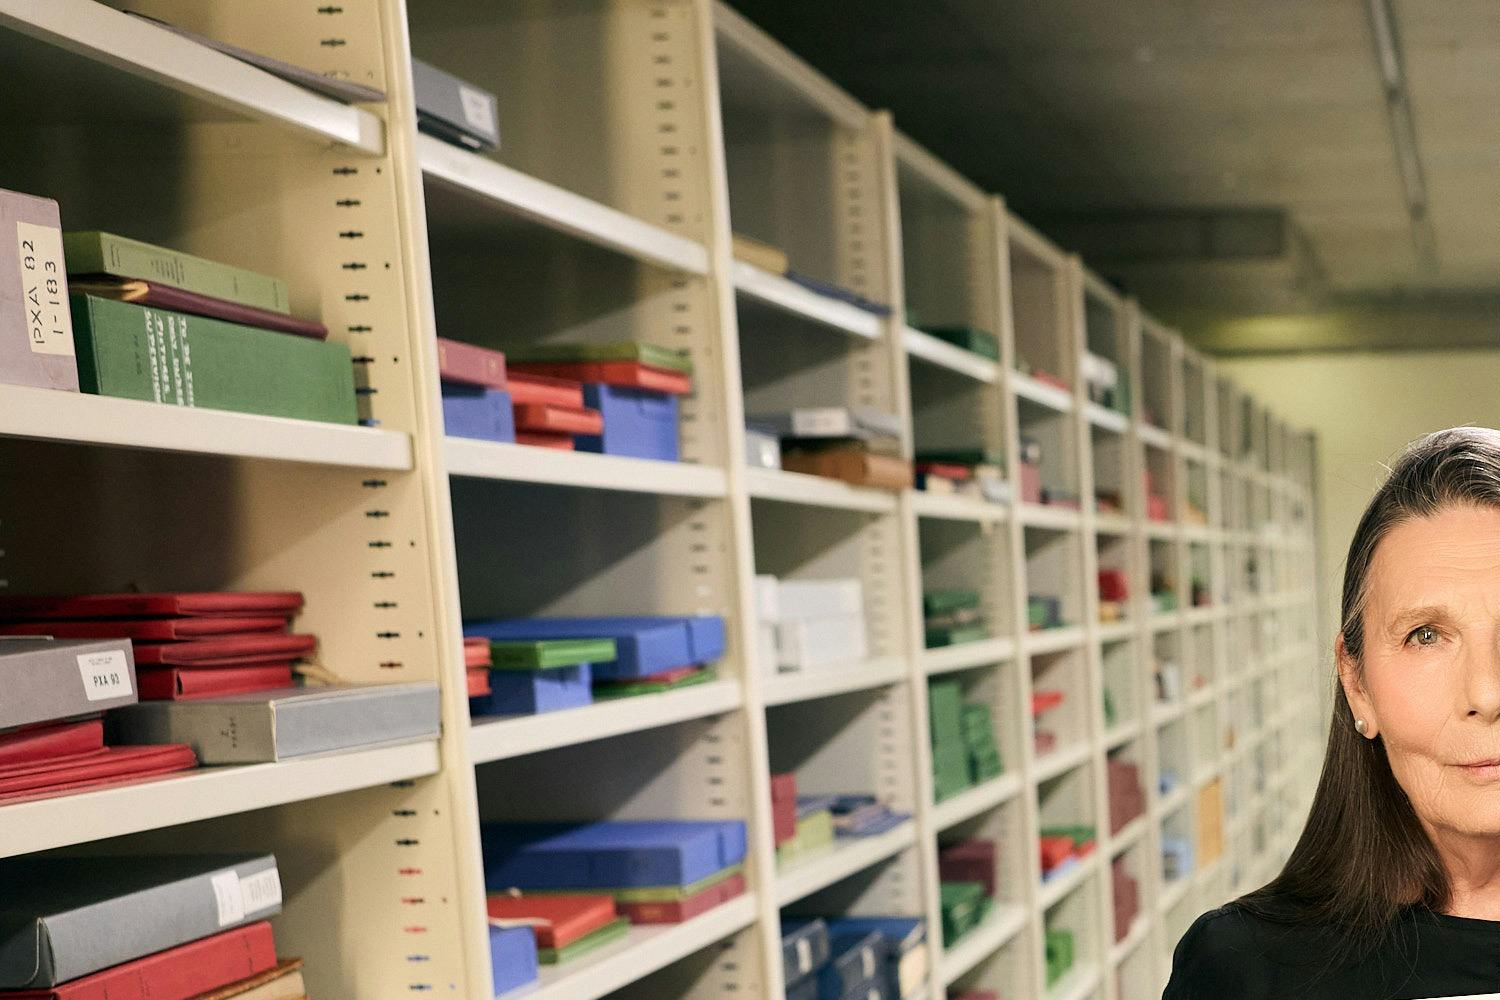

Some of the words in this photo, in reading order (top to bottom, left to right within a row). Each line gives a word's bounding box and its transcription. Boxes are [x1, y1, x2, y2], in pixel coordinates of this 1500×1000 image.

[22, 240, 35, 271] 82
[28, 286, 45, 344] PXA
[45, 261, 64, 334] 1-183
[93, 675, 108, 688] PXA
